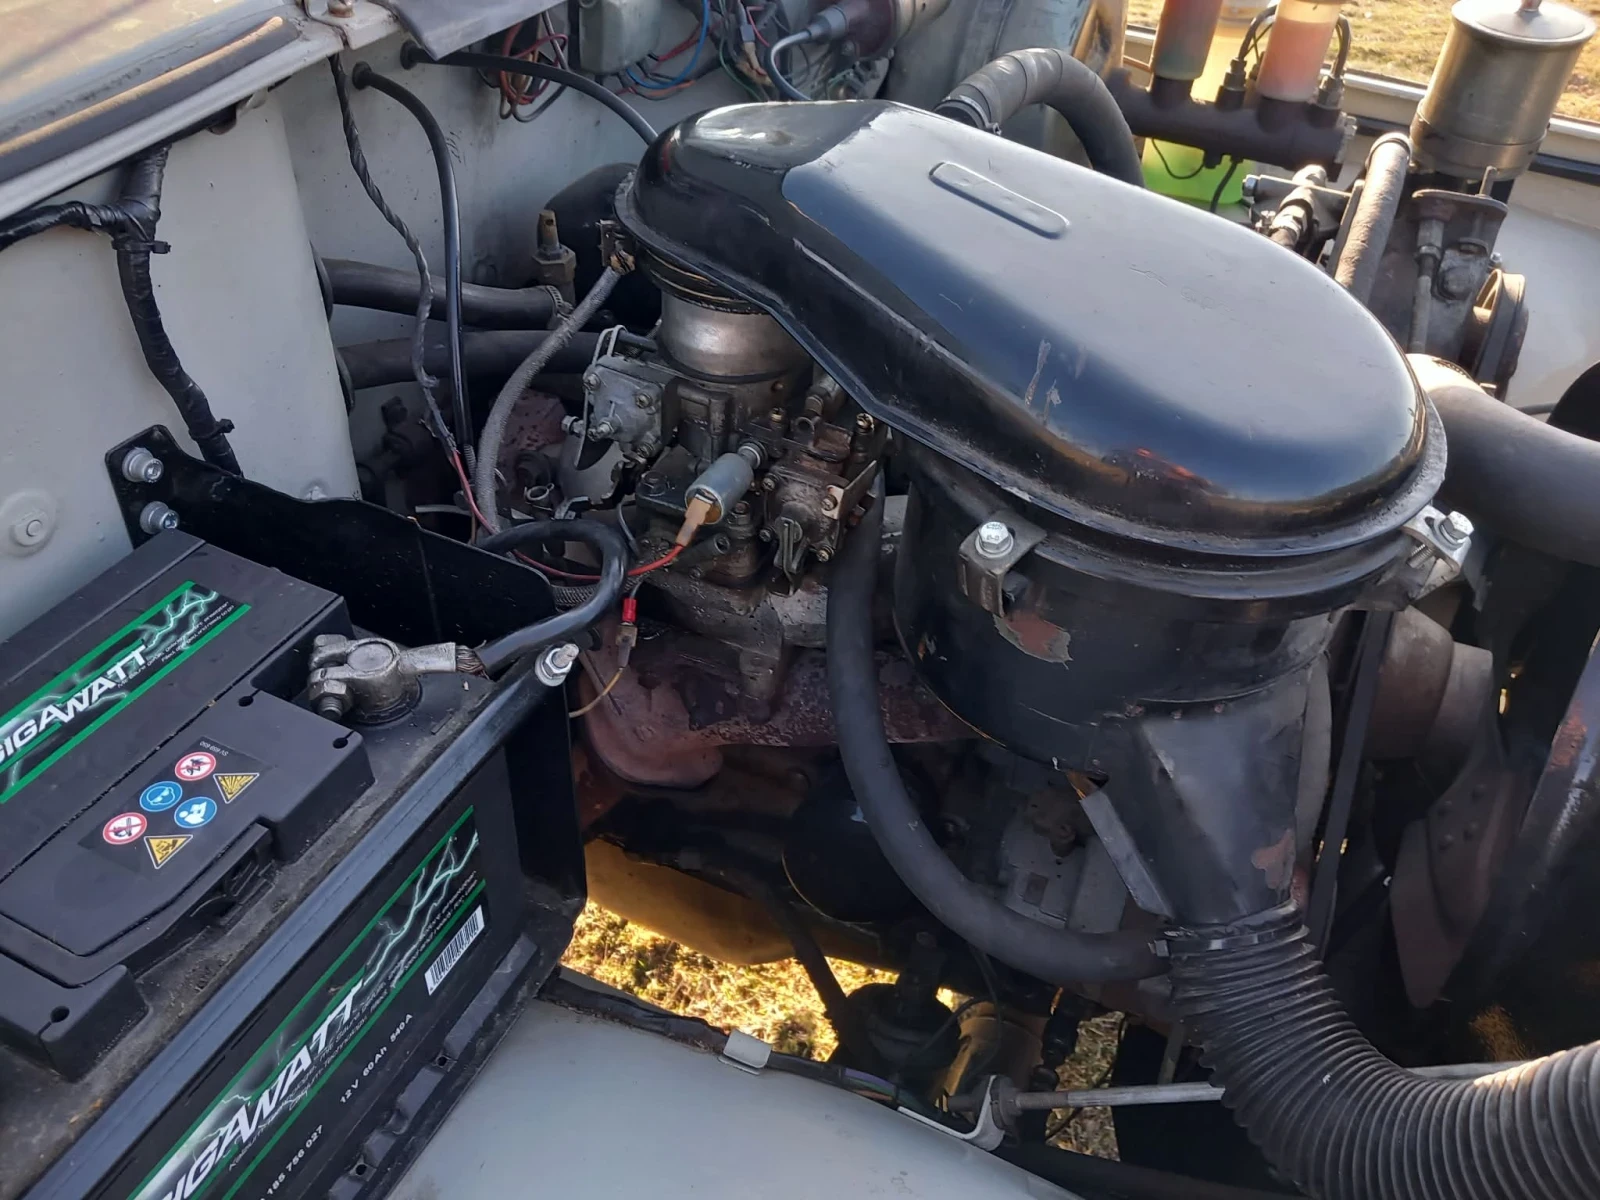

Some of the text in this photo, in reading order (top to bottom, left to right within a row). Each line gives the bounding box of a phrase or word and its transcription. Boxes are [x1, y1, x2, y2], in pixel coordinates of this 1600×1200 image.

[0, 644, 146, 764] IGAWATT
[162, 979, 363, 1200] IGAWATT
[363, 1046, 388, 1077] 60Ah
[390, 1014, 413, 1042] 540A
[267, 1124, 323, 1195] 185 756 027
